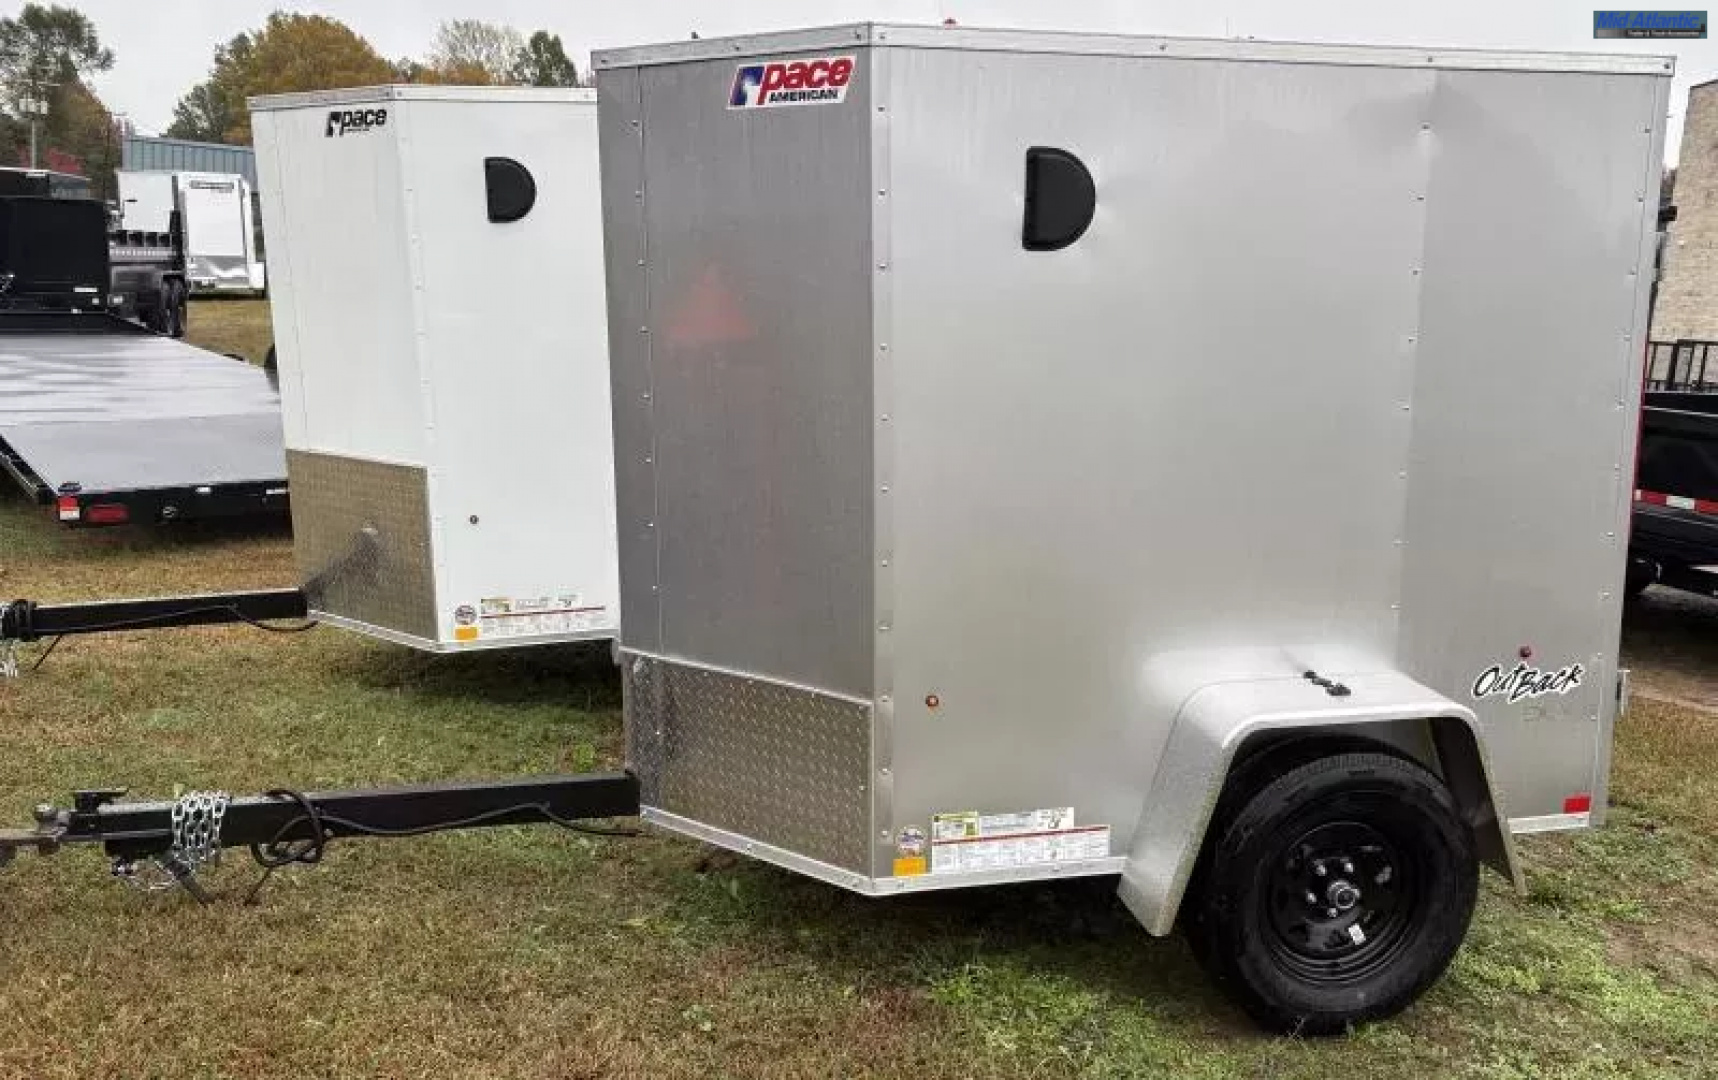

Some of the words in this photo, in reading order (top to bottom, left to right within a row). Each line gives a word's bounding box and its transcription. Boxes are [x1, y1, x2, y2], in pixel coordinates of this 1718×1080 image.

[756, 58, 853, 106] pace
[769, 89, 838, 103] AMERICAN
[339, 109, 387, 136] pace
